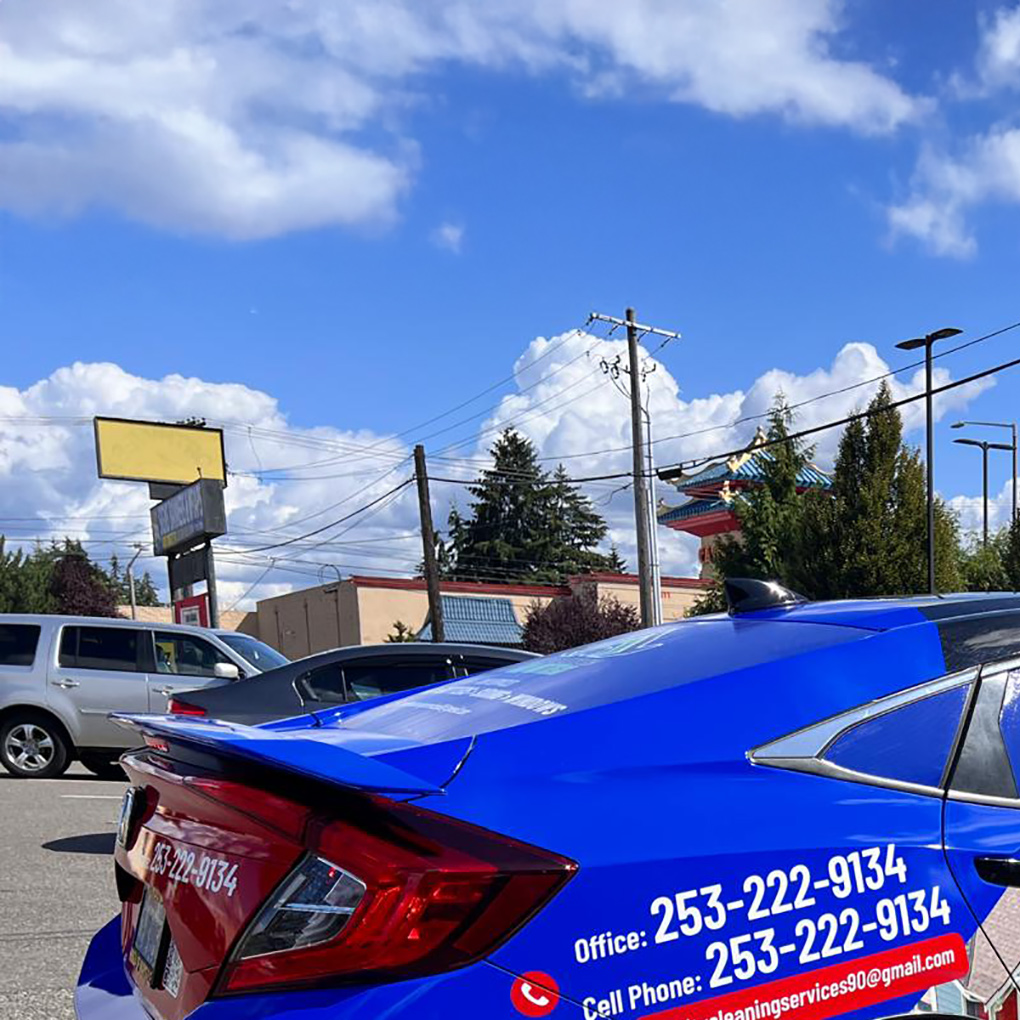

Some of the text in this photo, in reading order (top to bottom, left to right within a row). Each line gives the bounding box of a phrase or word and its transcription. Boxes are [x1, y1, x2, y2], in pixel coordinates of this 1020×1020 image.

[151, 842, 239, 896] 253-222-9134
[575, 844, 907, 964] Office: 253-222-9134
[628, 975, 702, 1012] Phone:
[705, 886, 951, 989] 253-222-9134
